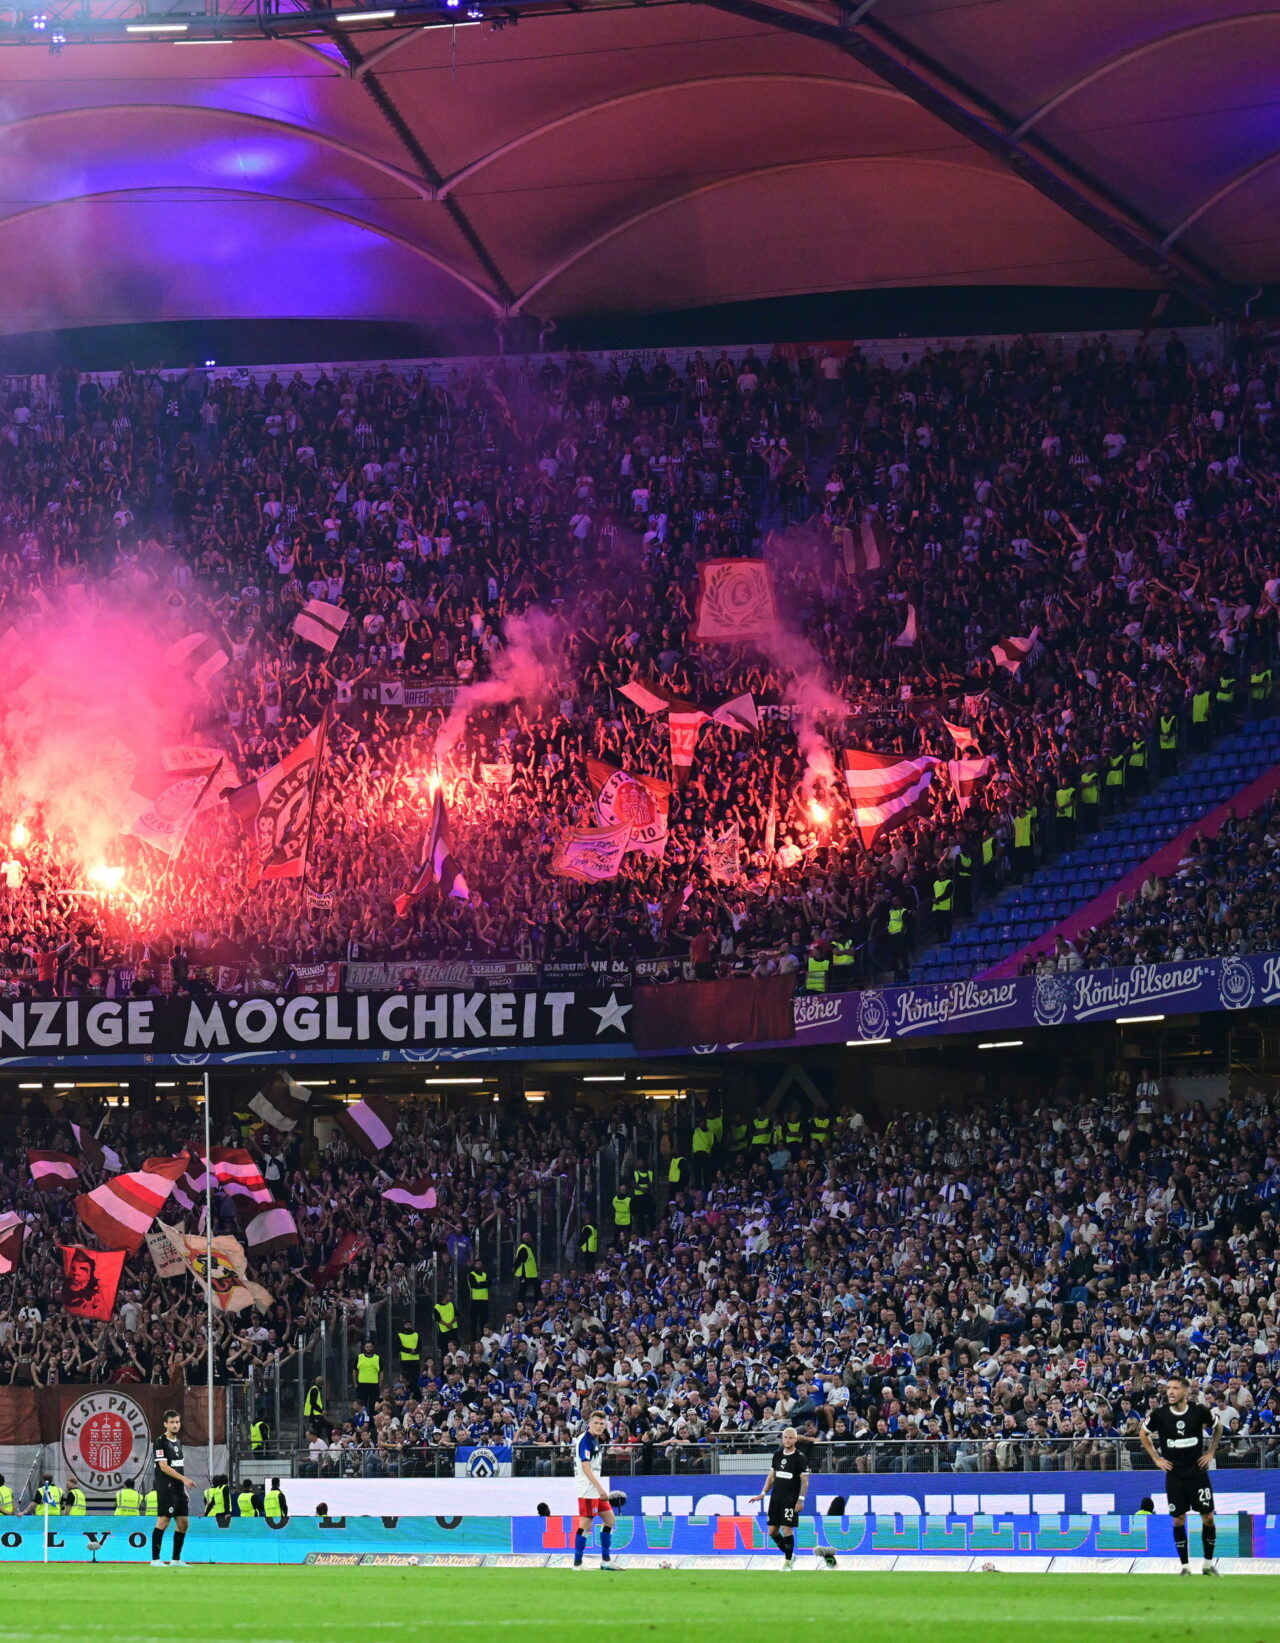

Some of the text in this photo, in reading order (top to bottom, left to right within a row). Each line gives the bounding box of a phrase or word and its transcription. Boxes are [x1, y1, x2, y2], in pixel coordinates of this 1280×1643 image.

[296, 963, 325, 977] GRINGO
[348, 964, 402, 985] ENFANTS
[544, 963, 586, 972] DARUM
[1075, 963, 1202, 1011] König Pilsener
[896, 981, 1017, 1027] König Pilsener
[183, 991, 575, 1048] MÖGLICHKEIT
[67, 1420, 82, 1437] FC
[108, 1396, 147, 1440] PAULI
[88, 1470, 122, 1488] 1910
[1198, 1488, 1211, 1501] 28
[784, 1508, 794, 1519] 23
[316, 1552, 359, 1566] buXtrade
